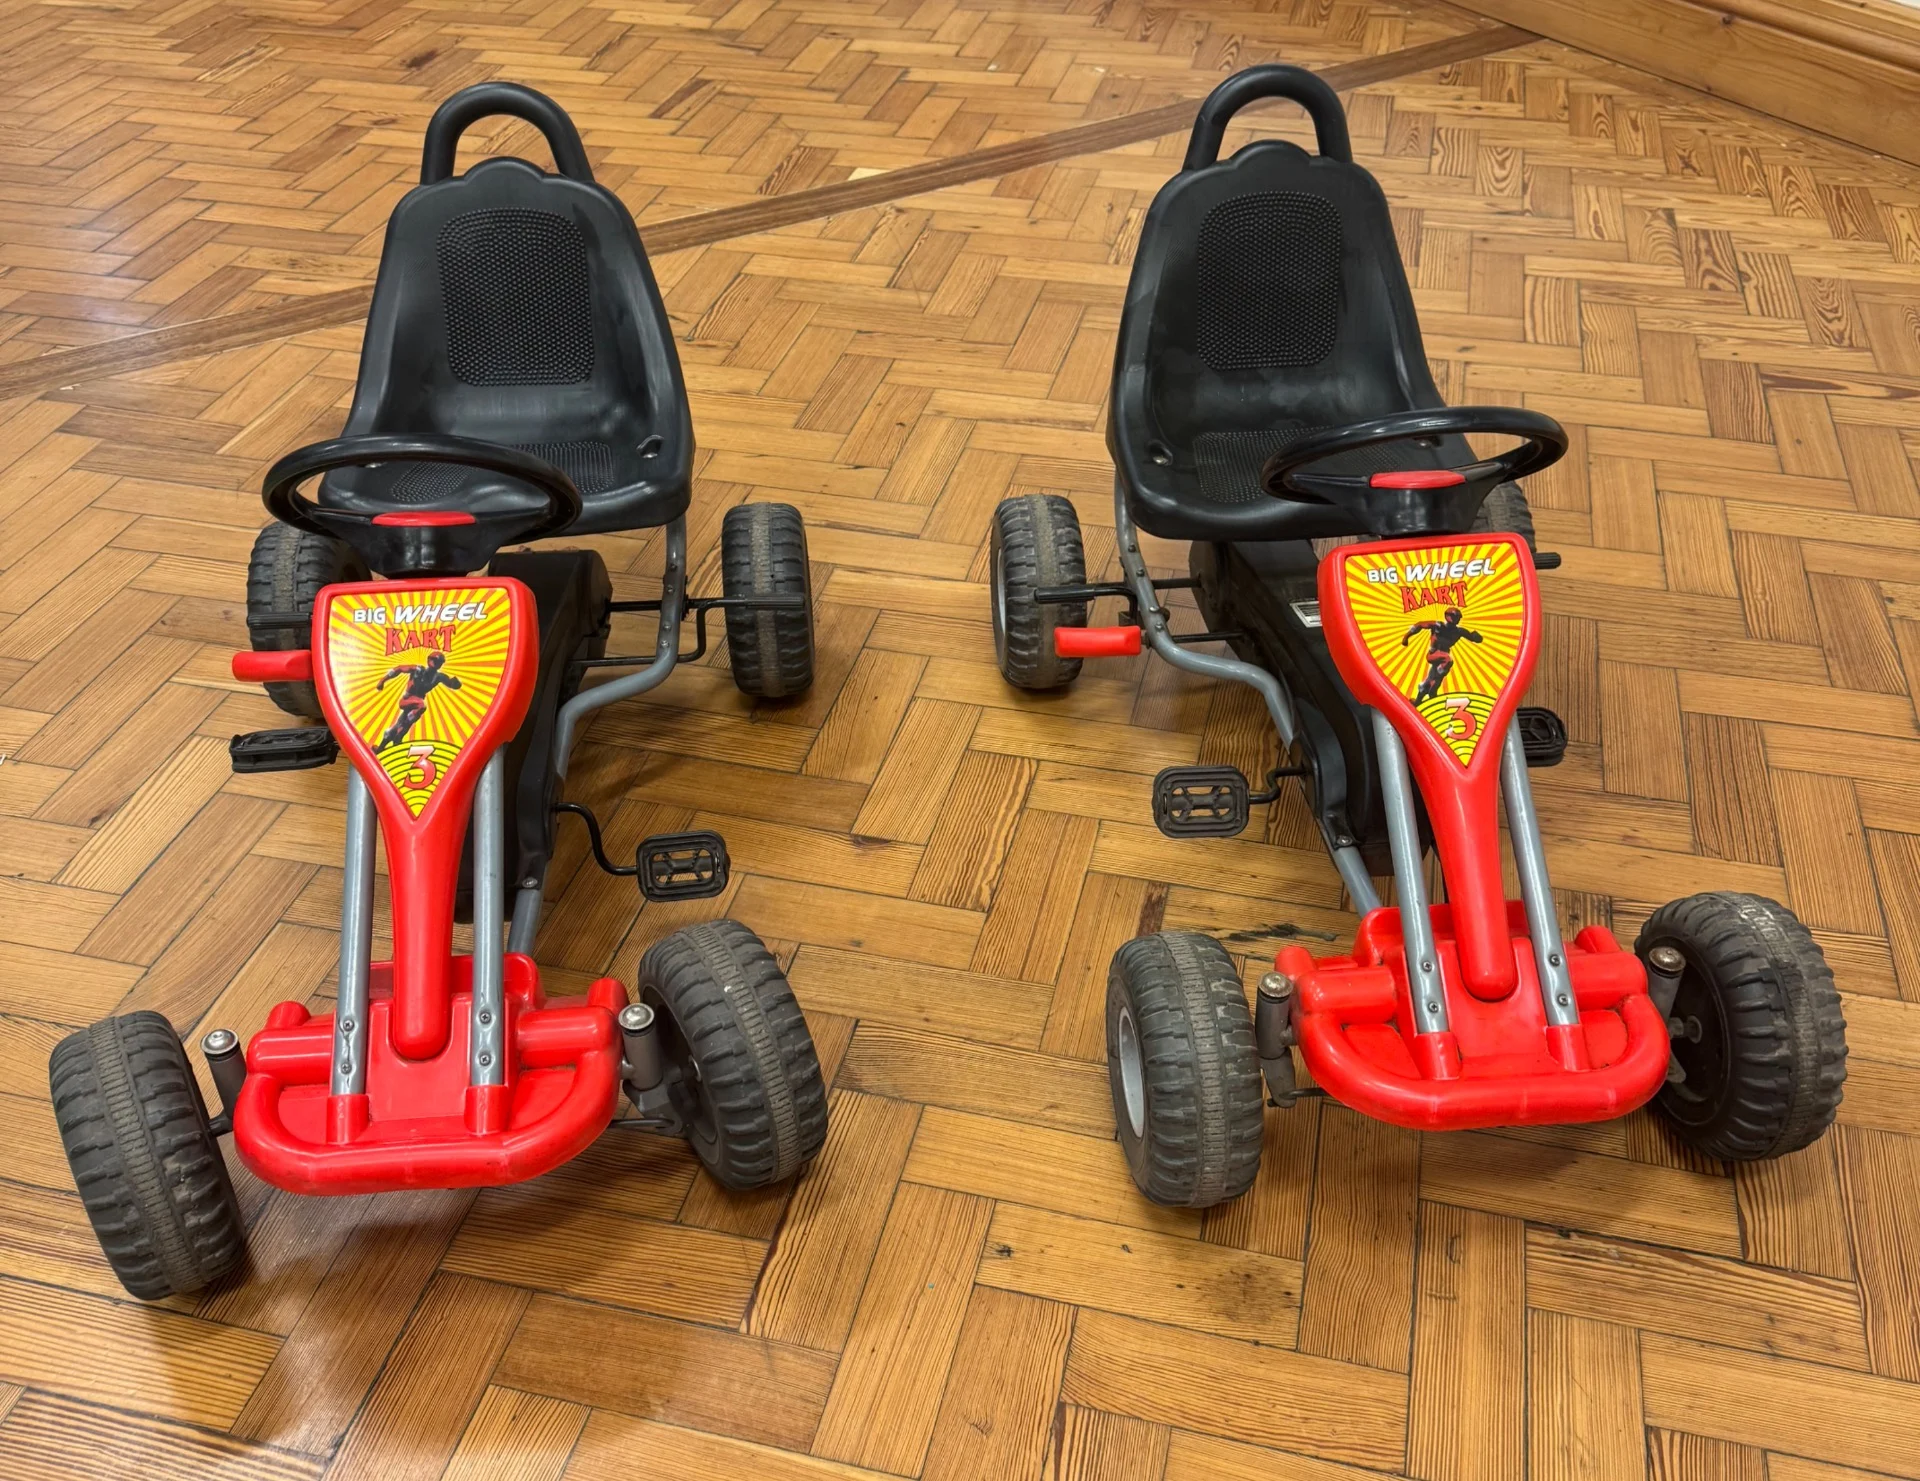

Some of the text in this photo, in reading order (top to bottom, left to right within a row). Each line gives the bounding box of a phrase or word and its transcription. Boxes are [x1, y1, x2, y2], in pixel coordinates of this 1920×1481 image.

[1367, 558, 1496, 584] BIG WHEEL
[353, 601, 489, 624] BIG WHEEL
[1400, 581, 1468, 614] KART
[385, 624, 456, 656] KART
[1445, 697, 1478, 740] 3
[403, 745, 437, 790] 3
